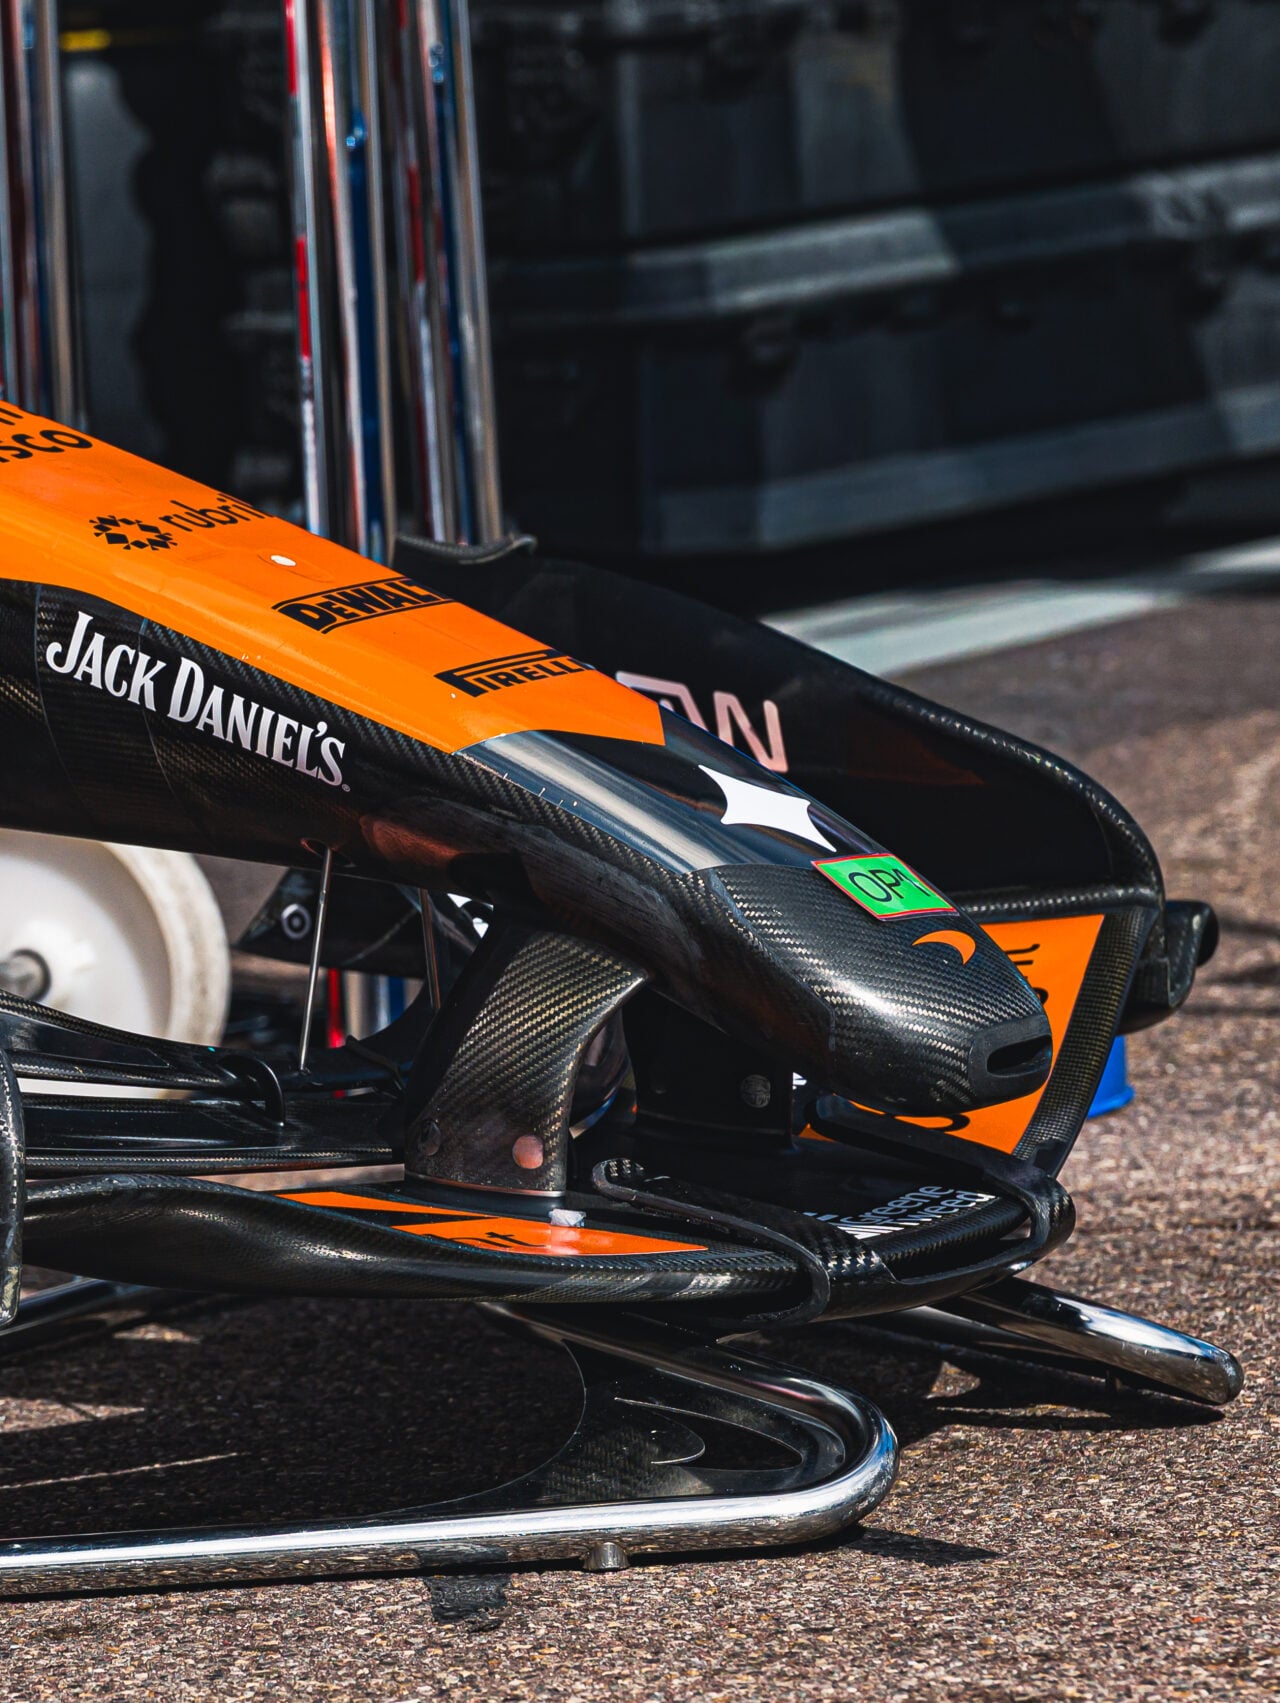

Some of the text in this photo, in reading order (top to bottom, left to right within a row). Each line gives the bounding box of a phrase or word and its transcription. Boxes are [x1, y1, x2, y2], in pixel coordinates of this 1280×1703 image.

[45, 610, 167, 713] JACK
[839, 1185, 955, 1226] Greene
[878, 1190, 997, 1227] Tweed
